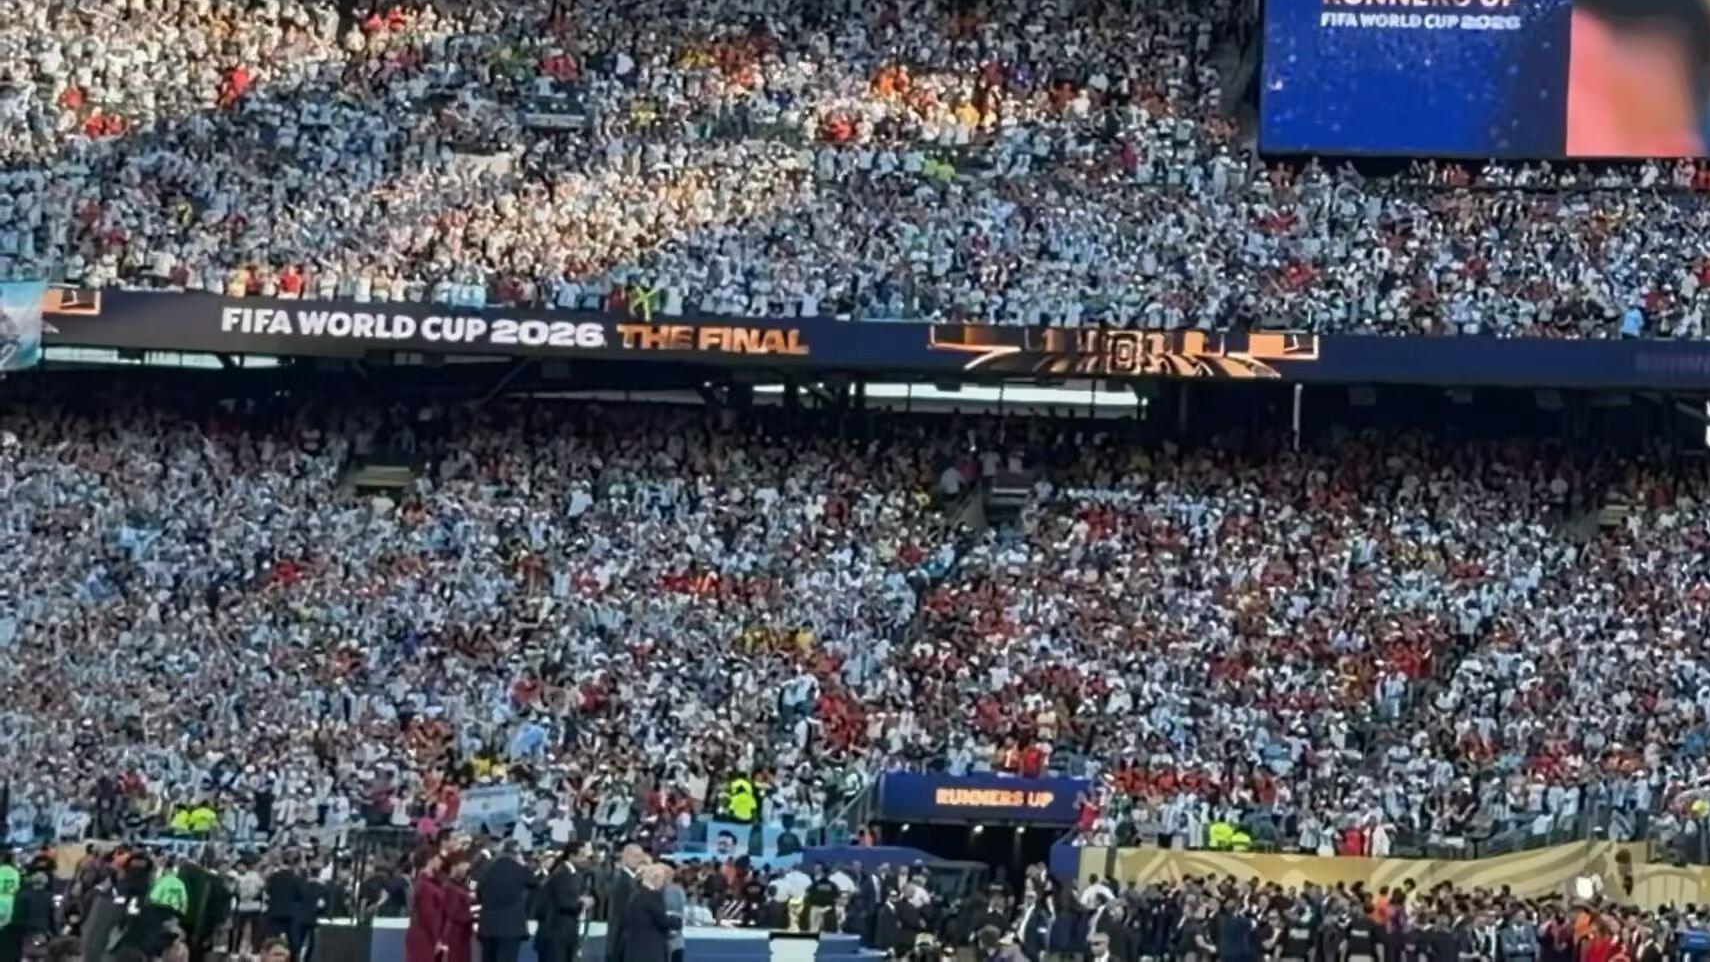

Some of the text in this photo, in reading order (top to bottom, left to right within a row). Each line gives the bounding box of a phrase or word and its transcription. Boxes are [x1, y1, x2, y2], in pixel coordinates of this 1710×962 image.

[1320, 11, 1522, 31] FIFA WORLD CUP 2026
[221, 306, 811, 356] FIFA WORLD CUP 2026 THE FINAL
[934, 787, 1054, 808] RUNNERS UP
